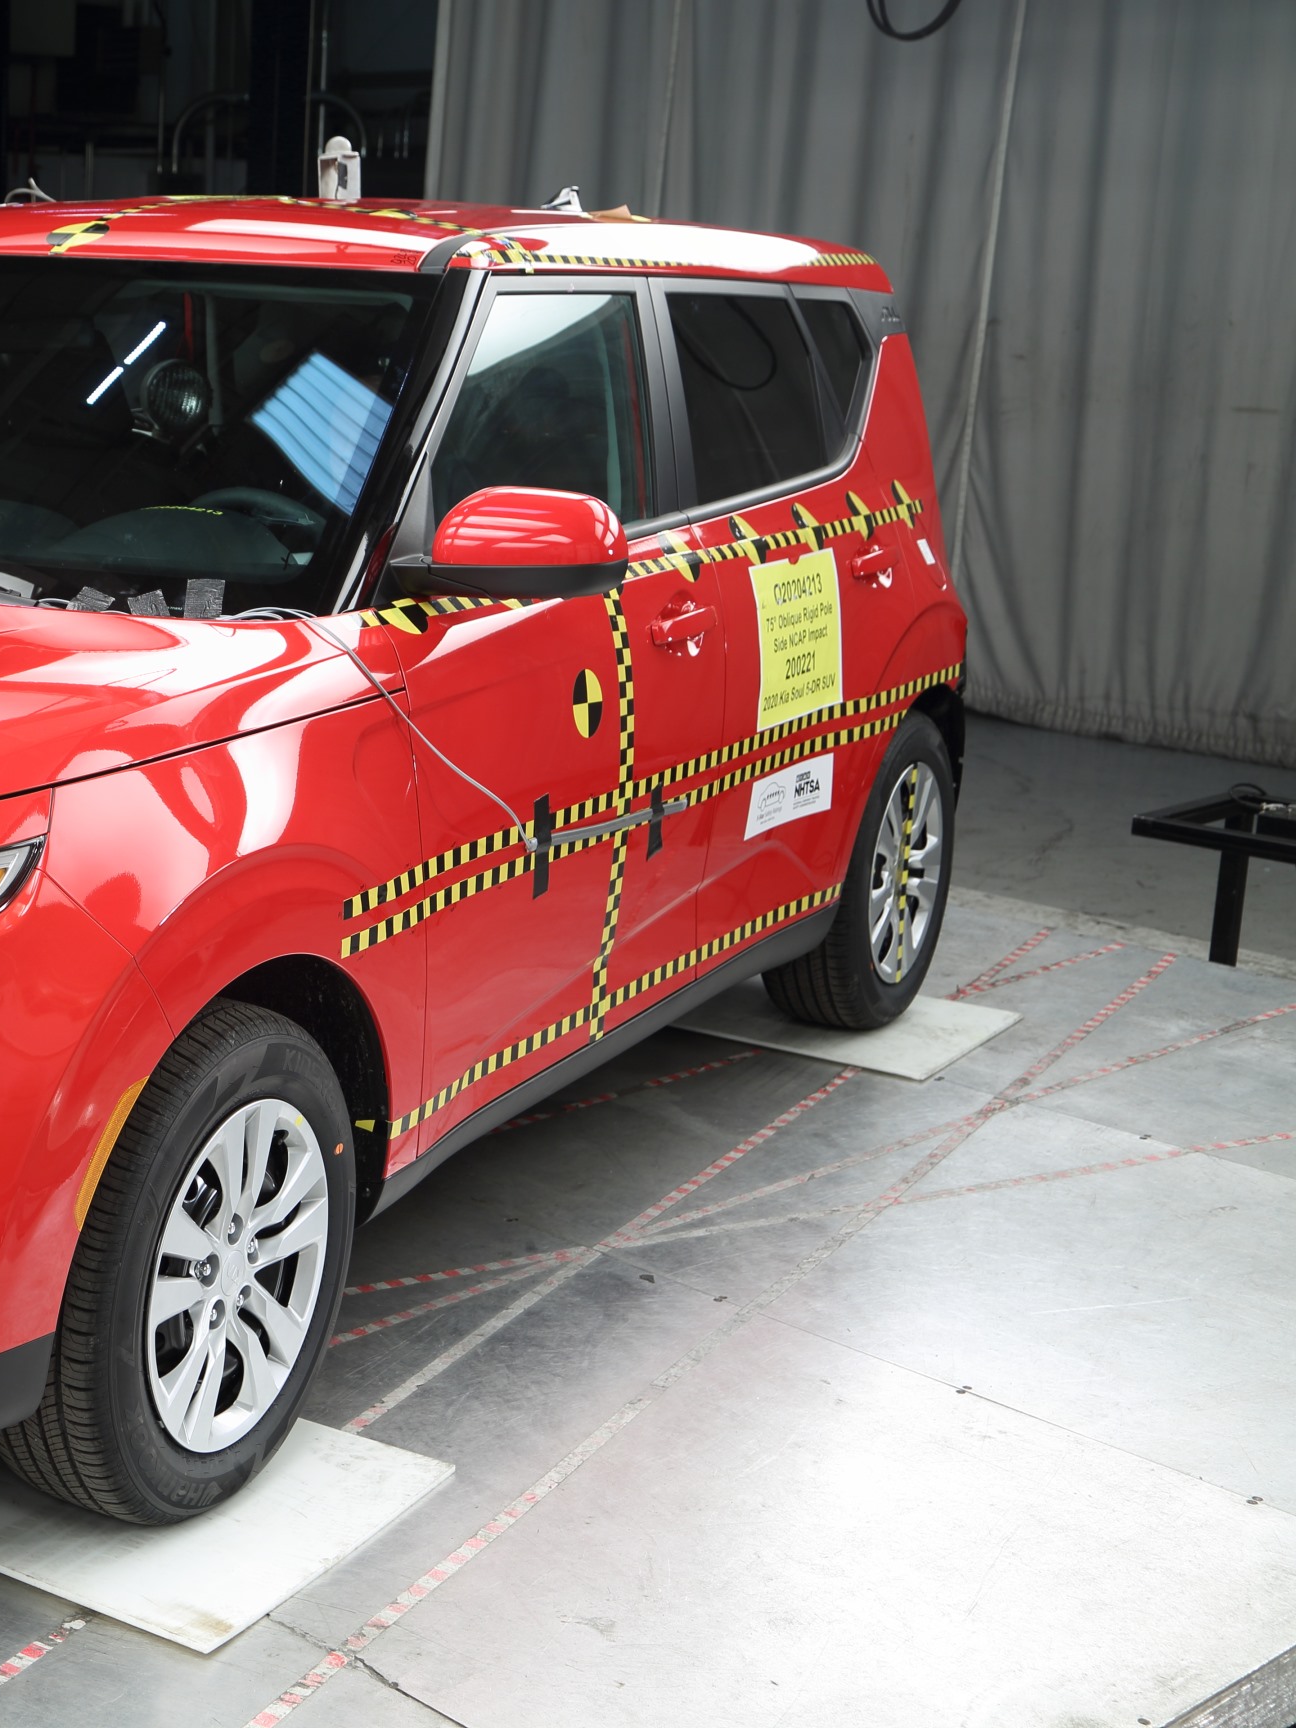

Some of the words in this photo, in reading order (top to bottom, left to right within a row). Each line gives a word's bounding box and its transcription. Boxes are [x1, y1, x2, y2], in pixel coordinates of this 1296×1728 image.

[774, 573, 822, 605] Q20204213
[779, 610, 802, 629] Oblique
[803, 606, 818, 623] Rigid
[820, 602, 832, 616] Pole
[774, 638, 787, 653] Side
[789, 630, 806, 647] NCAP
[808, 624, 828, 642] Impact
[786, 650, 815, 680] 200221
[763, 695, 777, 712] 2020
[780, 689, 790, 705] Kia
[791, 684, 804, 700] Soul
[806, 678, 821, 695] 5-DR
[822, 673, 836, 689] SUV
[794, 779, 820, 798] NHTSA
